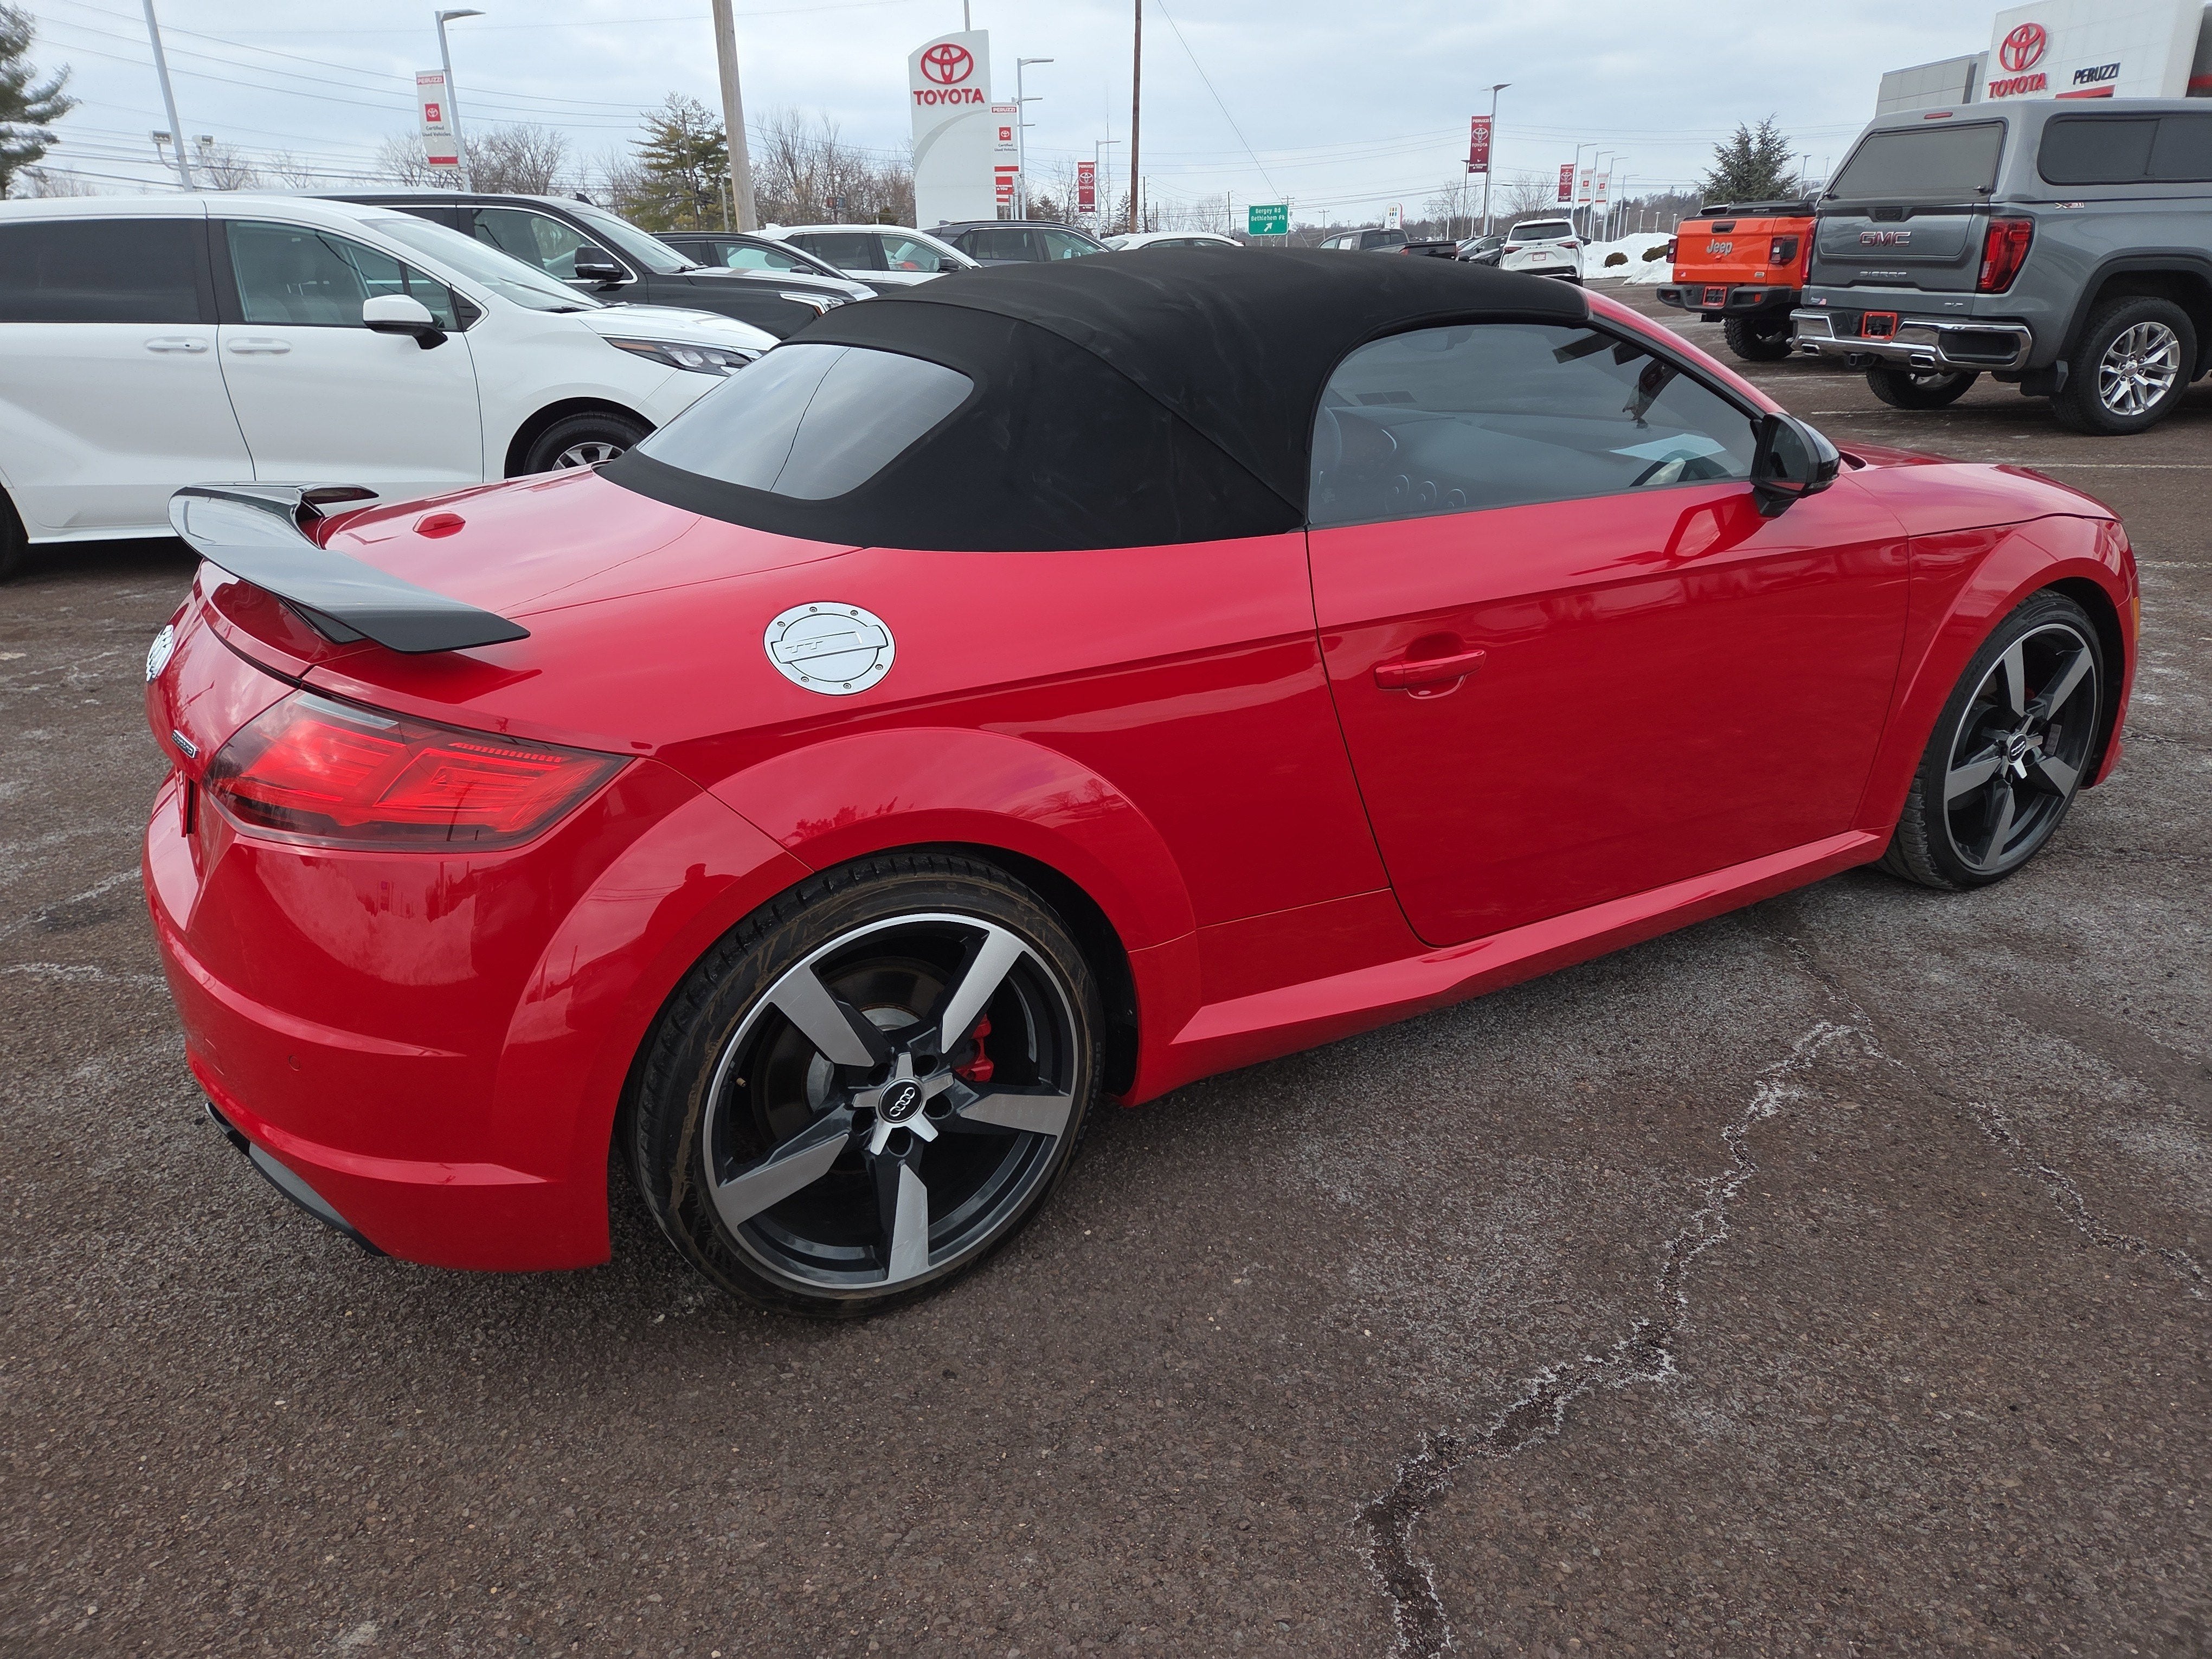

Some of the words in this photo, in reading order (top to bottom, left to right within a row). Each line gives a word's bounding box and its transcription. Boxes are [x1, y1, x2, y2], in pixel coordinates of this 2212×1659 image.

[2073, 62, 2120, 85] PERUZZI
[1989, 72, 2047, 99] TOYOTA
[913, 88, 985, 105] TOYOTA
[1706, 239, 1733, 256] Jeep
[1859, 232, 1911, 246] GMC
[785, 641, 823, 653] TT
